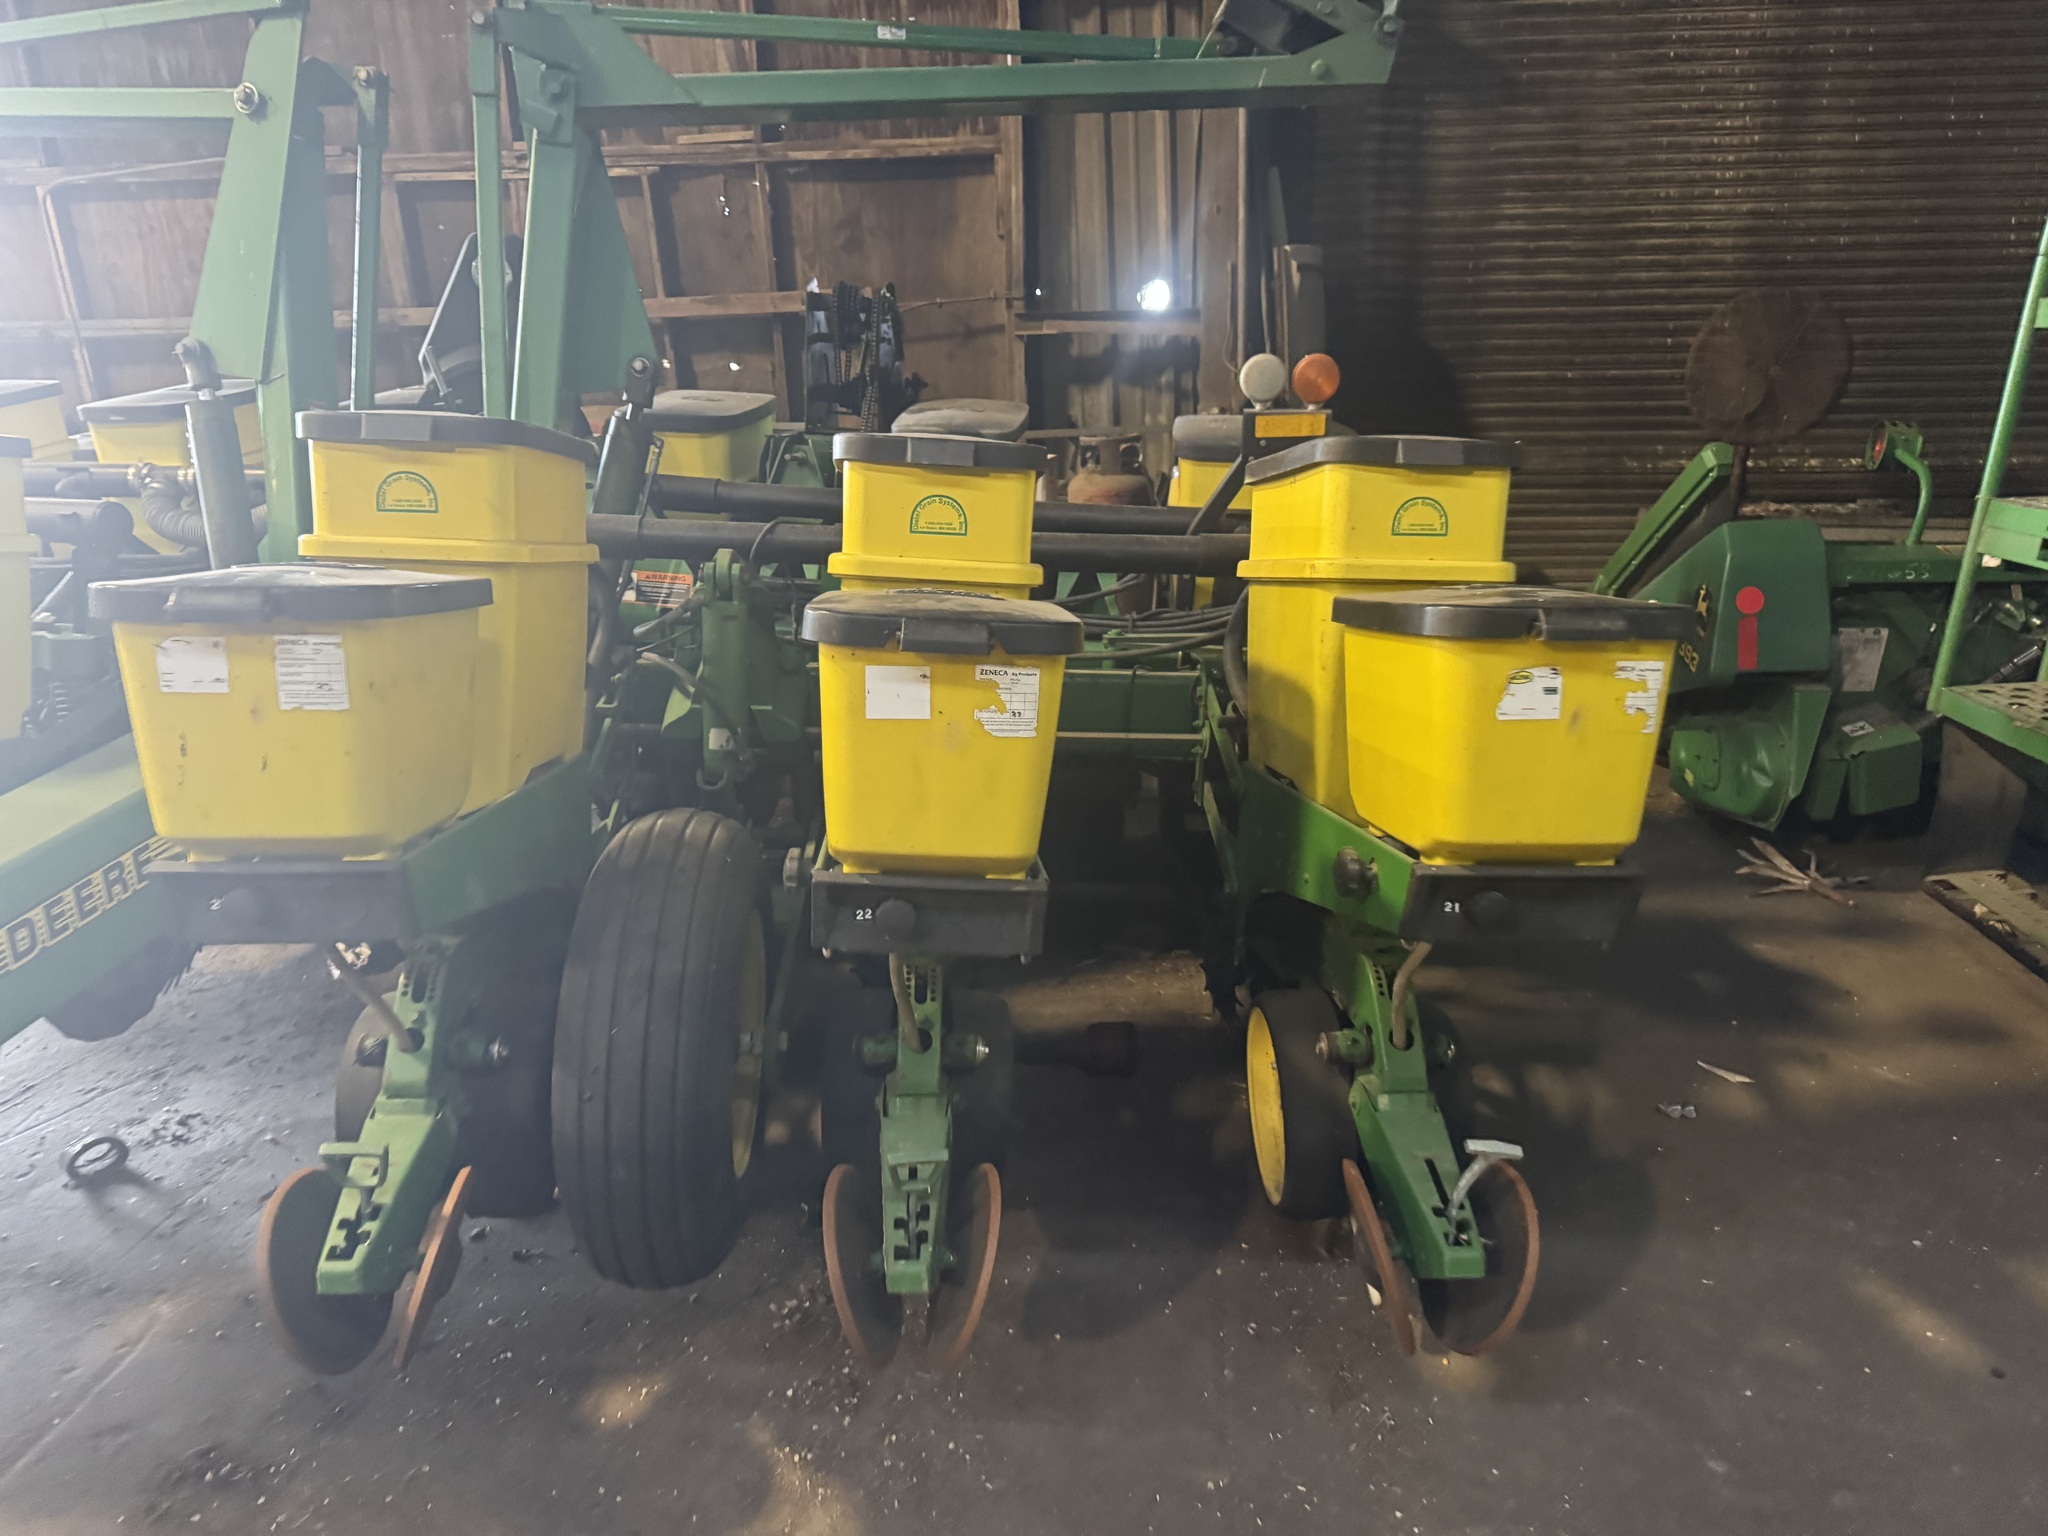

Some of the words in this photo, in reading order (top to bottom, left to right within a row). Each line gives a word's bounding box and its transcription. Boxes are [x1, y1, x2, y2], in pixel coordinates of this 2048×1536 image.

[650, 573, 687, 582] WARNING
[979, 668, 1009, 676] ZENECA
[5, 841, 152, 966] DEERE
[1443, 901, 1460, 913] 21
[855, 908, 873, 920] 22
